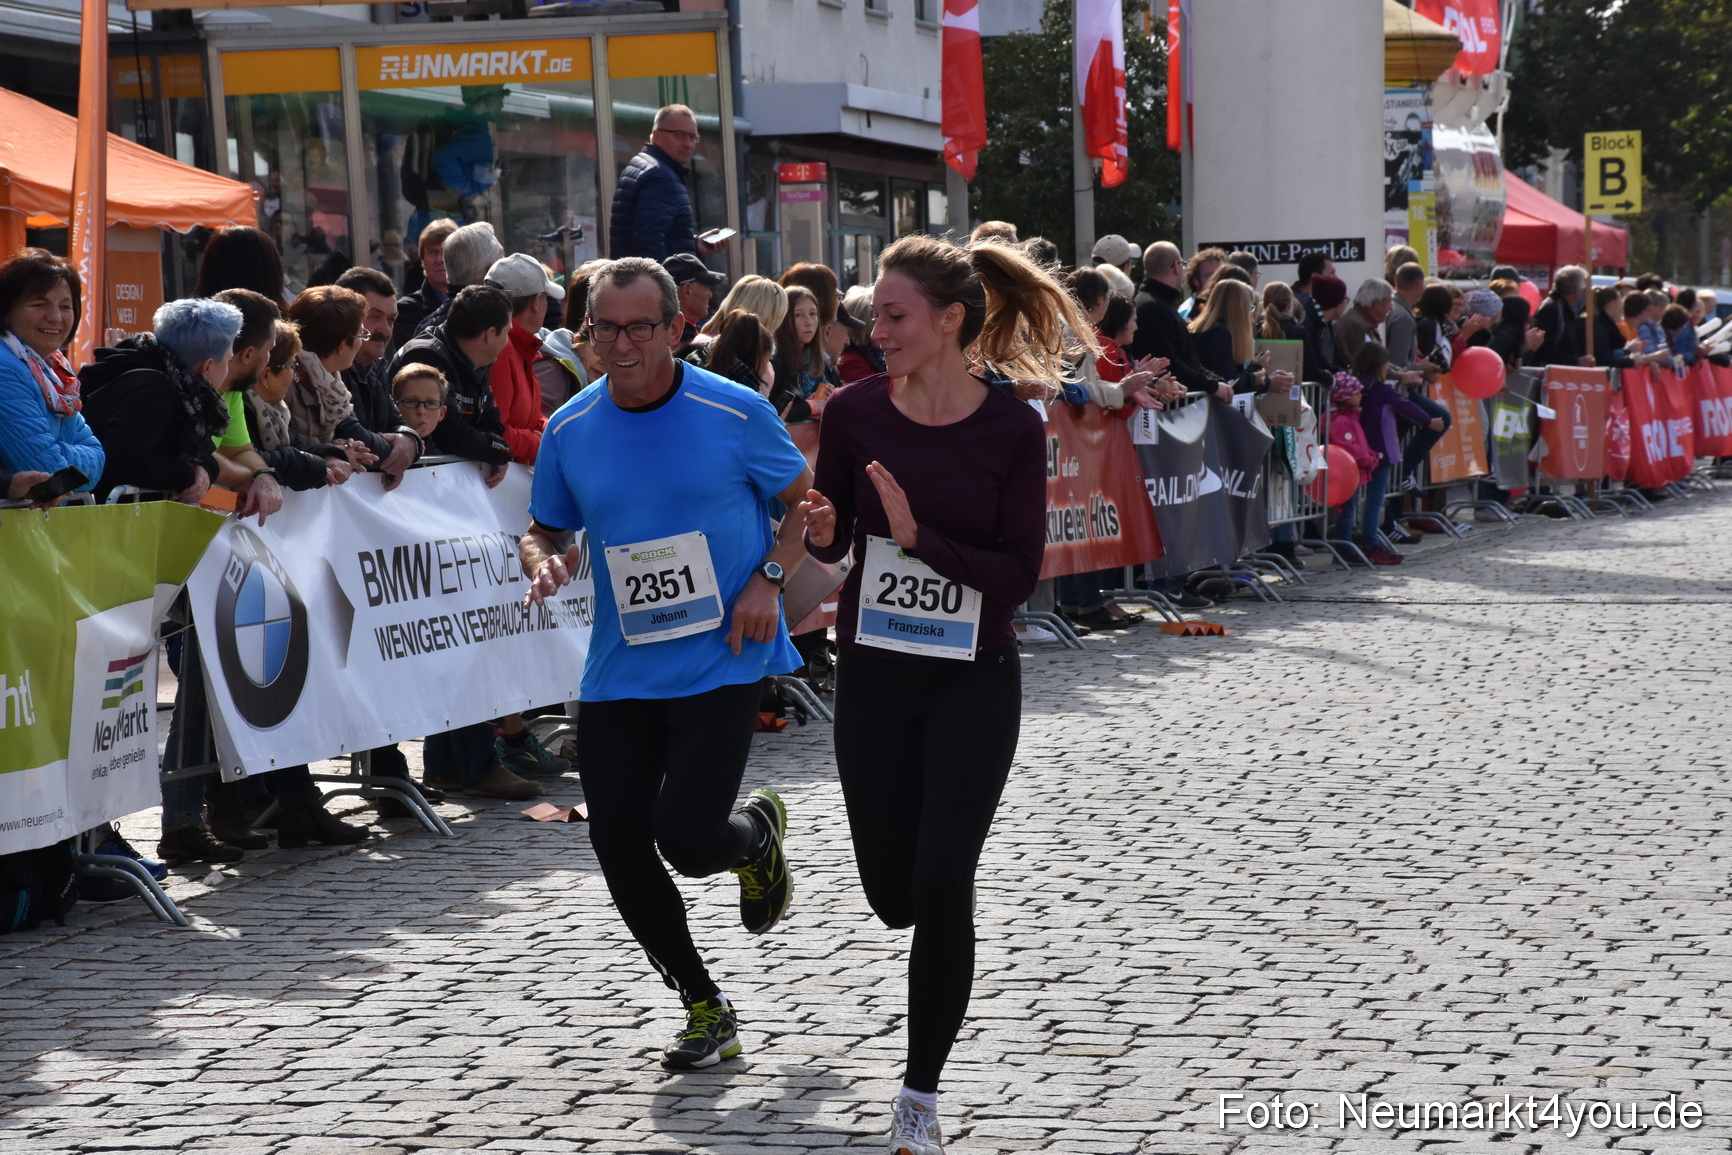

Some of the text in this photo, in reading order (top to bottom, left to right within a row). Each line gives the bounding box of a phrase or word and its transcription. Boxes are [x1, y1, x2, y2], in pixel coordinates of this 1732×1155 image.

[379, 50, 573, 81] RUNMARKT.DE
[1591, 134, 1635, 151] Block
[1600, 157, 1627, 196] B
[117, 308, 133, 324] WEB
[1090, 490, 1119, 538] Hits
[640, 546, 676, 561] BOCK
[358, 541, 431, 608] BMW
[625, 564, 696, 606] 2351
[876, 572, 963, 614] 2350
[650, 609, 688, 625] Johann
[887, 618, 945, 638] Franziska
[374, 610, 459, 662] WENIGER
